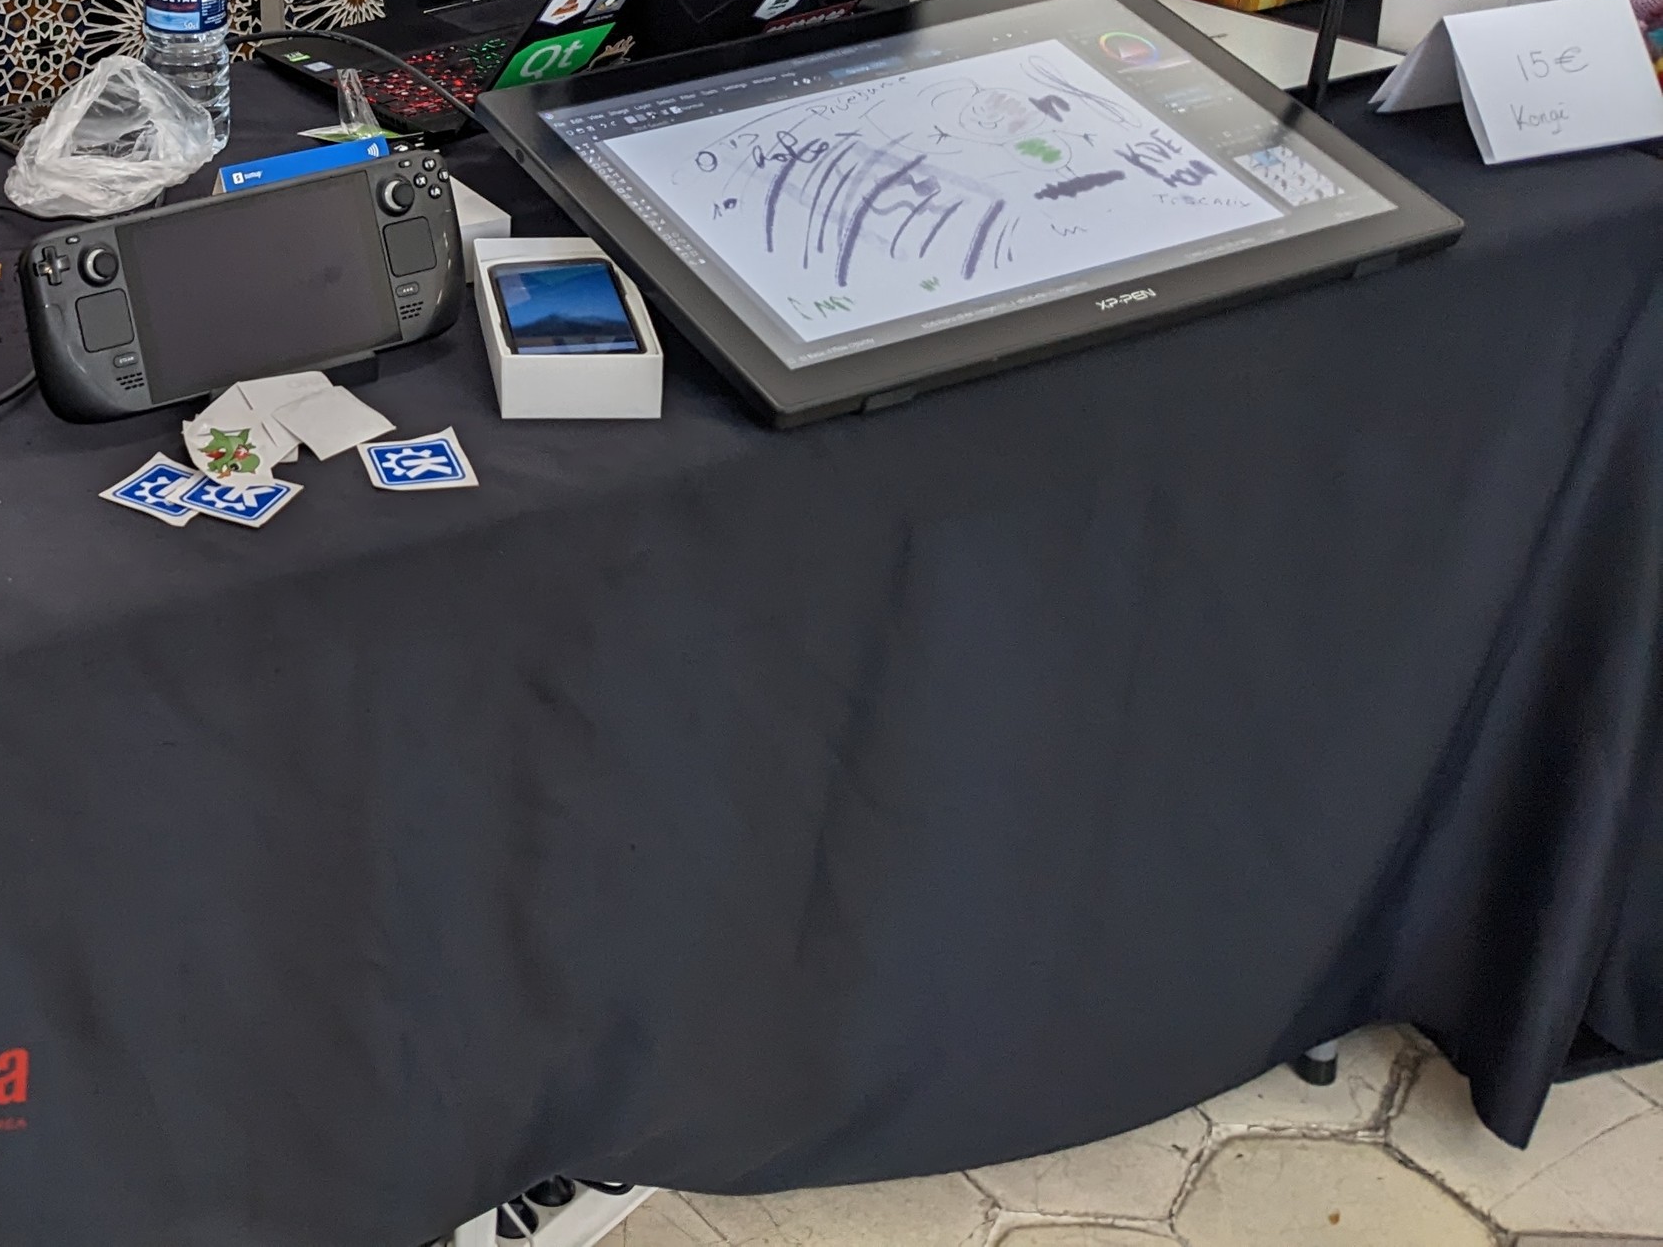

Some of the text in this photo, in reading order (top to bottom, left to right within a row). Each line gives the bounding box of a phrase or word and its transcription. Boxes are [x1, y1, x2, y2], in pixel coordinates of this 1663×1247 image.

[519, 39, 585, 80] Qt
[1517, 45, 1589, 82] 15€
[1095, 287, 1157, 310] XP-PEN
